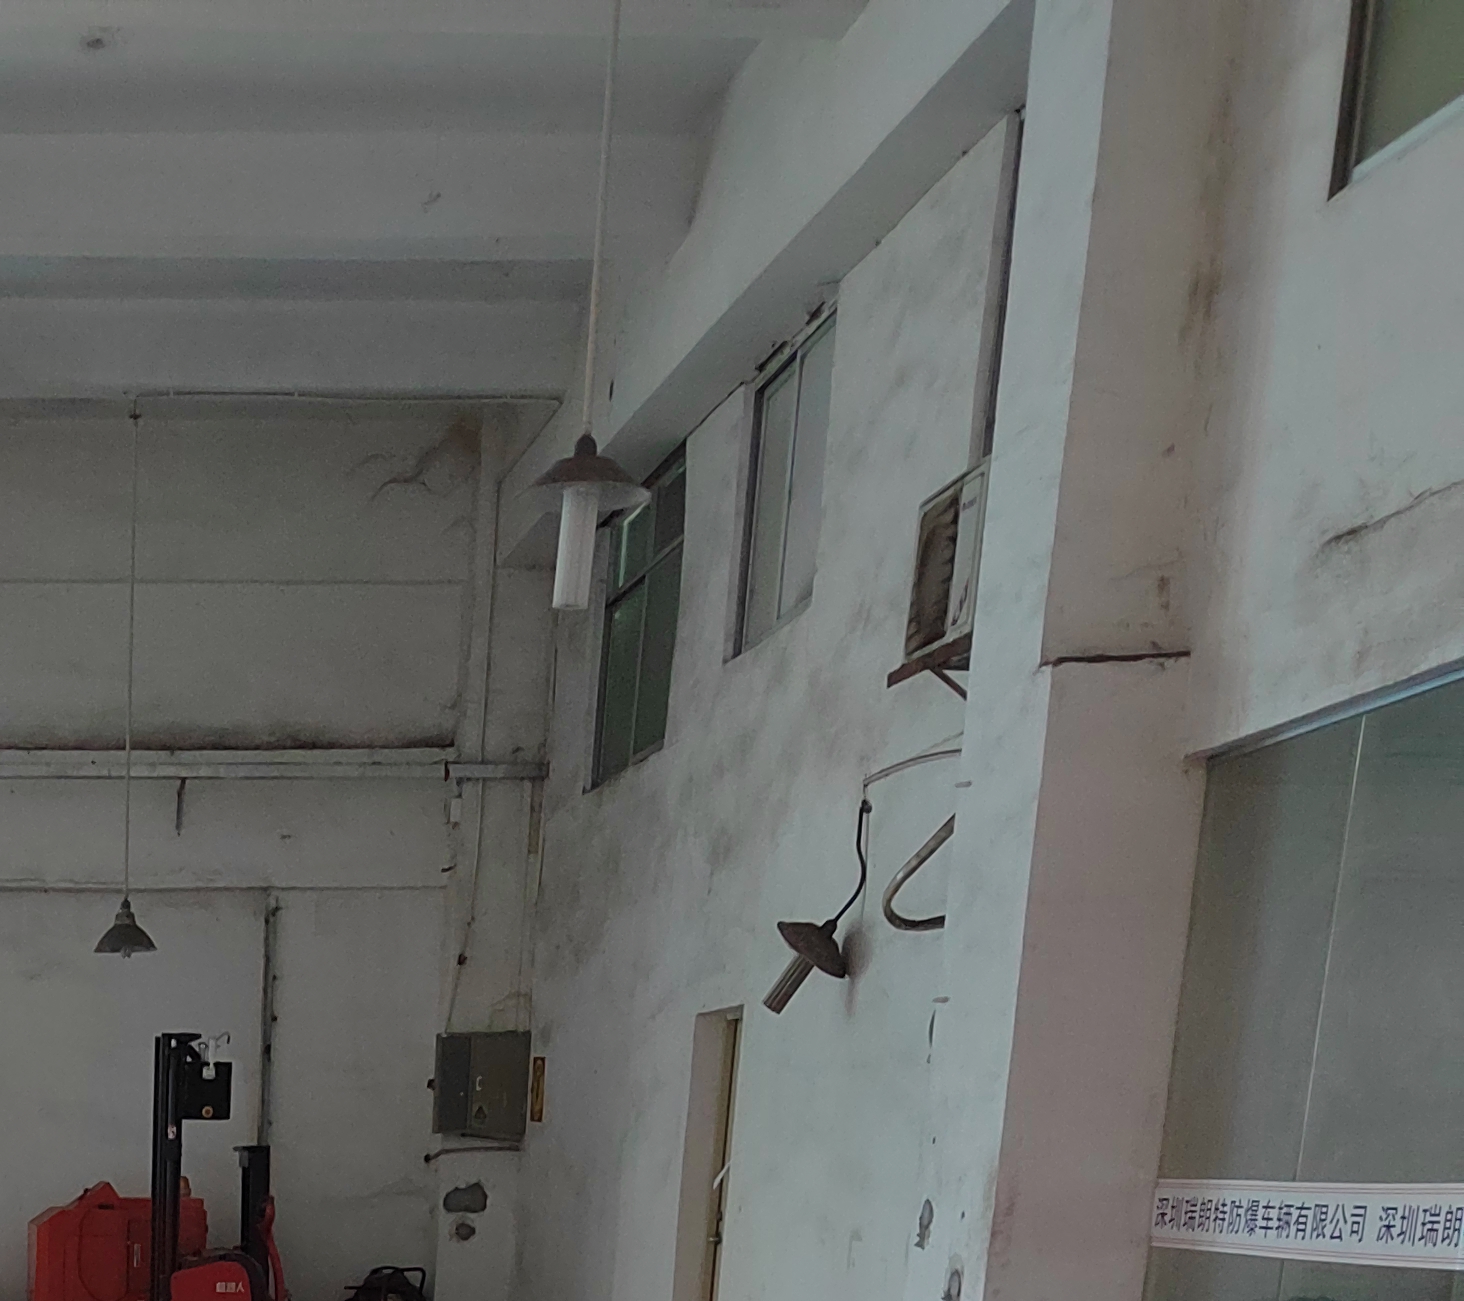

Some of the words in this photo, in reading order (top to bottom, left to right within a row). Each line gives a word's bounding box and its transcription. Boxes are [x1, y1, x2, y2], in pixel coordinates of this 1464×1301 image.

[1154, 1196, 1368, 1243] 深圳瑞朗特防爆车辆有限公司
[1375, 1203, 1463, 1248] 深圳瑞朗
